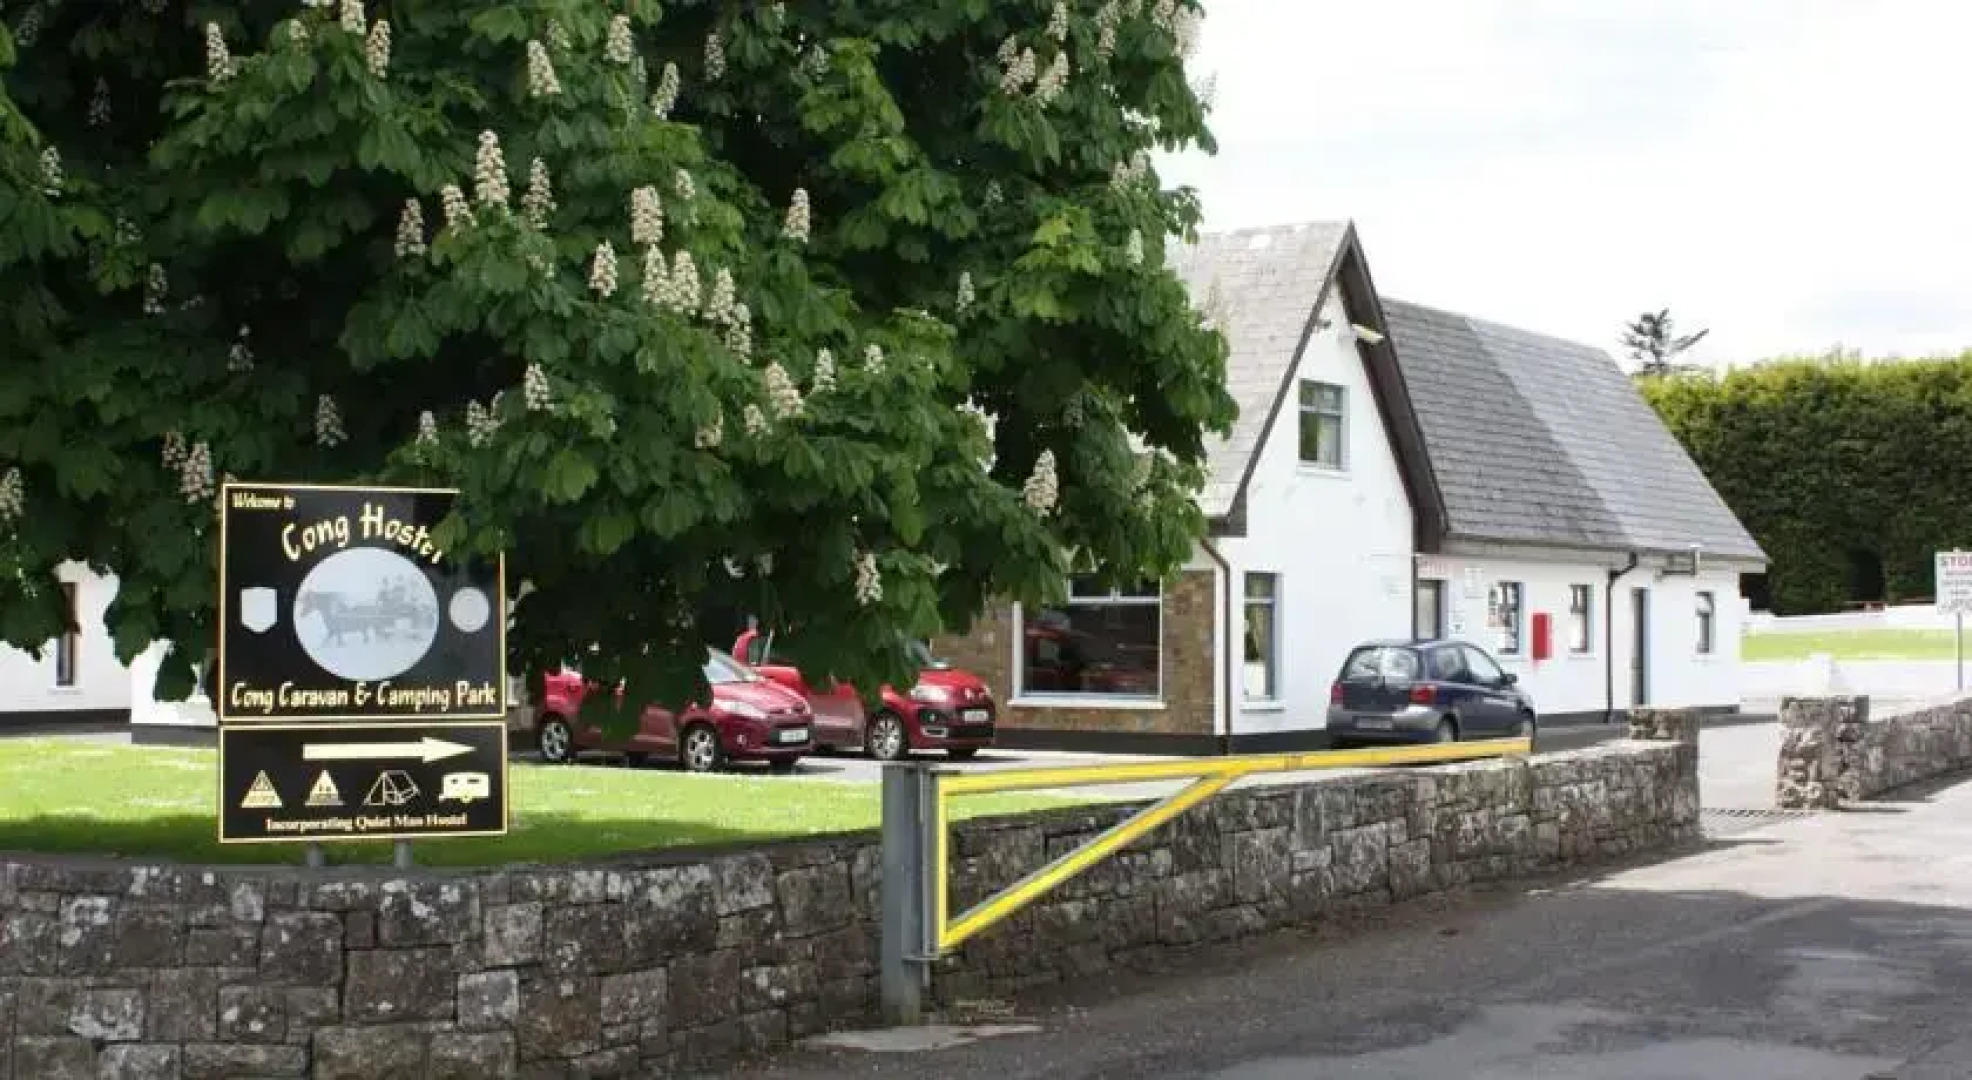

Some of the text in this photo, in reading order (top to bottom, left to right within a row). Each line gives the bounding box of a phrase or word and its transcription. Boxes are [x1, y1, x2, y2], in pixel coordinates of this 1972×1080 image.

[281, 514, 350, 562] Cong
[1938, 555, 1972, 567] STO
[231, 679, 496, 714] Cong Caravan & Camping Park
[265, 812, 468, 833] Incorporating Quiet Man Hostel
